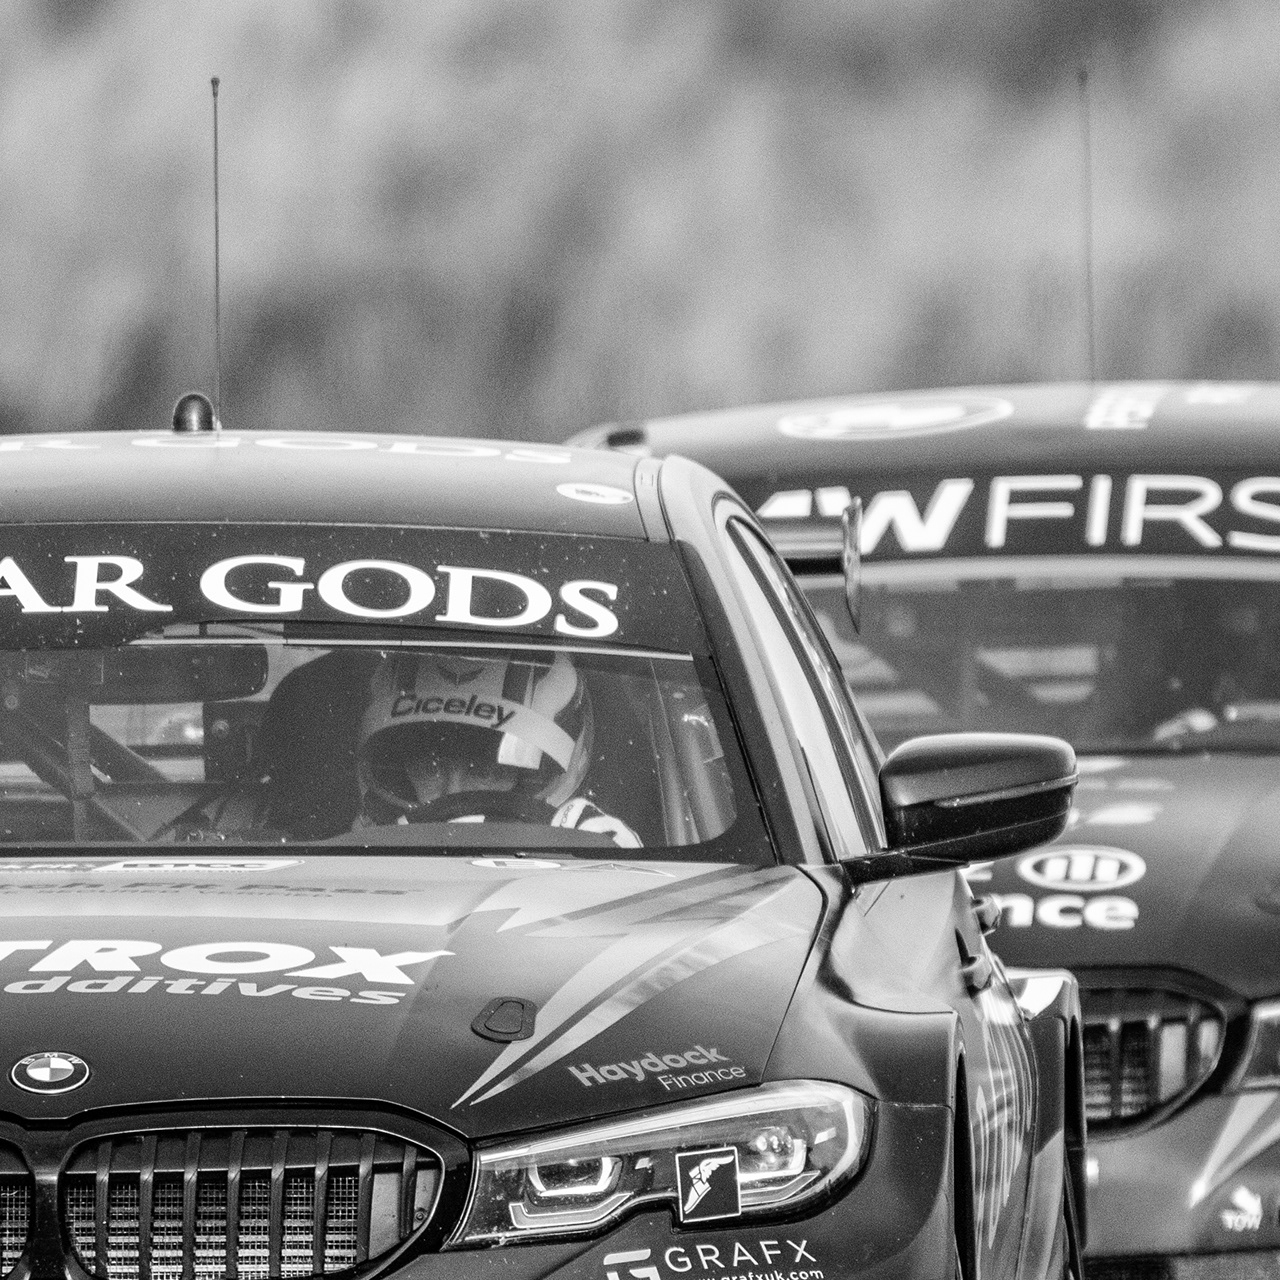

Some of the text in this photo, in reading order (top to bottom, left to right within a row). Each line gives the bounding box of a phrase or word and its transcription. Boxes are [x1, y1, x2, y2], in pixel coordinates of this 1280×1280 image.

[198, 554, 619, 638] GODS
[567, 1045, 730, 1087] Haydock
[657, 1066, 747, 1091] Finance
[664, 1239, 818, 1273] GRAFX
